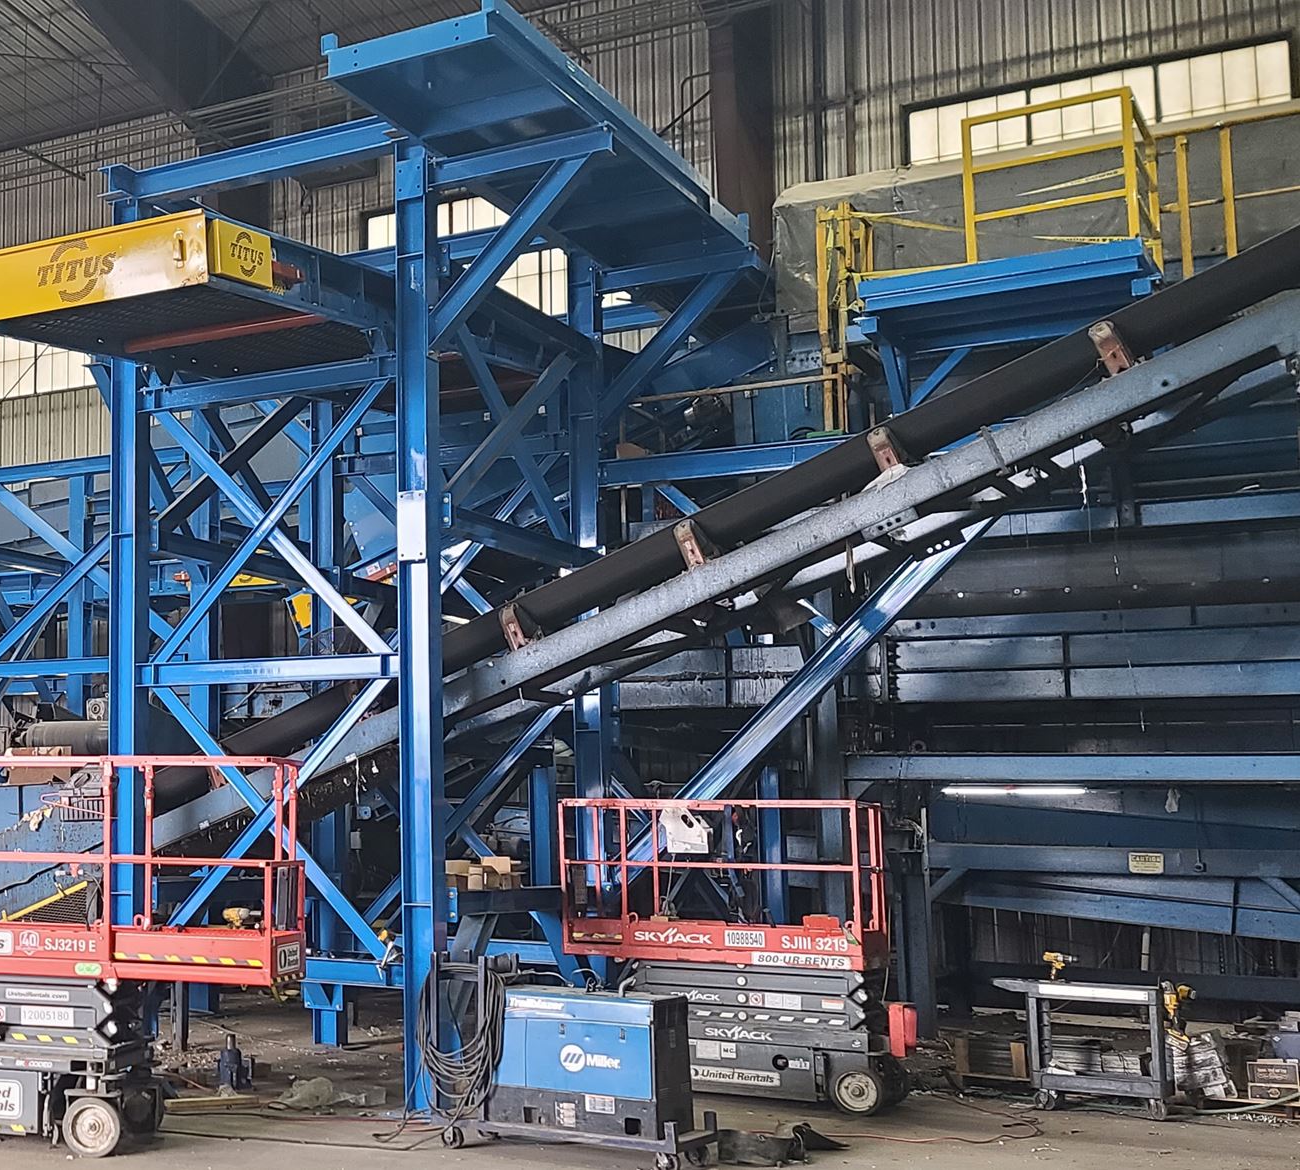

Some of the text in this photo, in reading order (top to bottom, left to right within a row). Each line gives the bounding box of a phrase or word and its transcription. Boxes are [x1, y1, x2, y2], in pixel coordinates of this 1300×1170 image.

[230, 241, 265, 266] TITUS
[36, 251, 117, 288] TITUS
[21, 933, 37, 947] 40
[634, 927, 712, 945] SKYJACK
[726, 932, 764, 947] 10988540
[44, 938, 96, 952] SJ3219 E
[815, 936, 848, 952] 3219
[757, 954, 845, 967] 800-UR-RENTS
[22, 1010, 69, 1021] 12005180
[704, 1026, 773, 1041] SKYJACK
[586, 1054, 621, 1069] Miller
[701, 1070, 774, 1084] United Rentals
